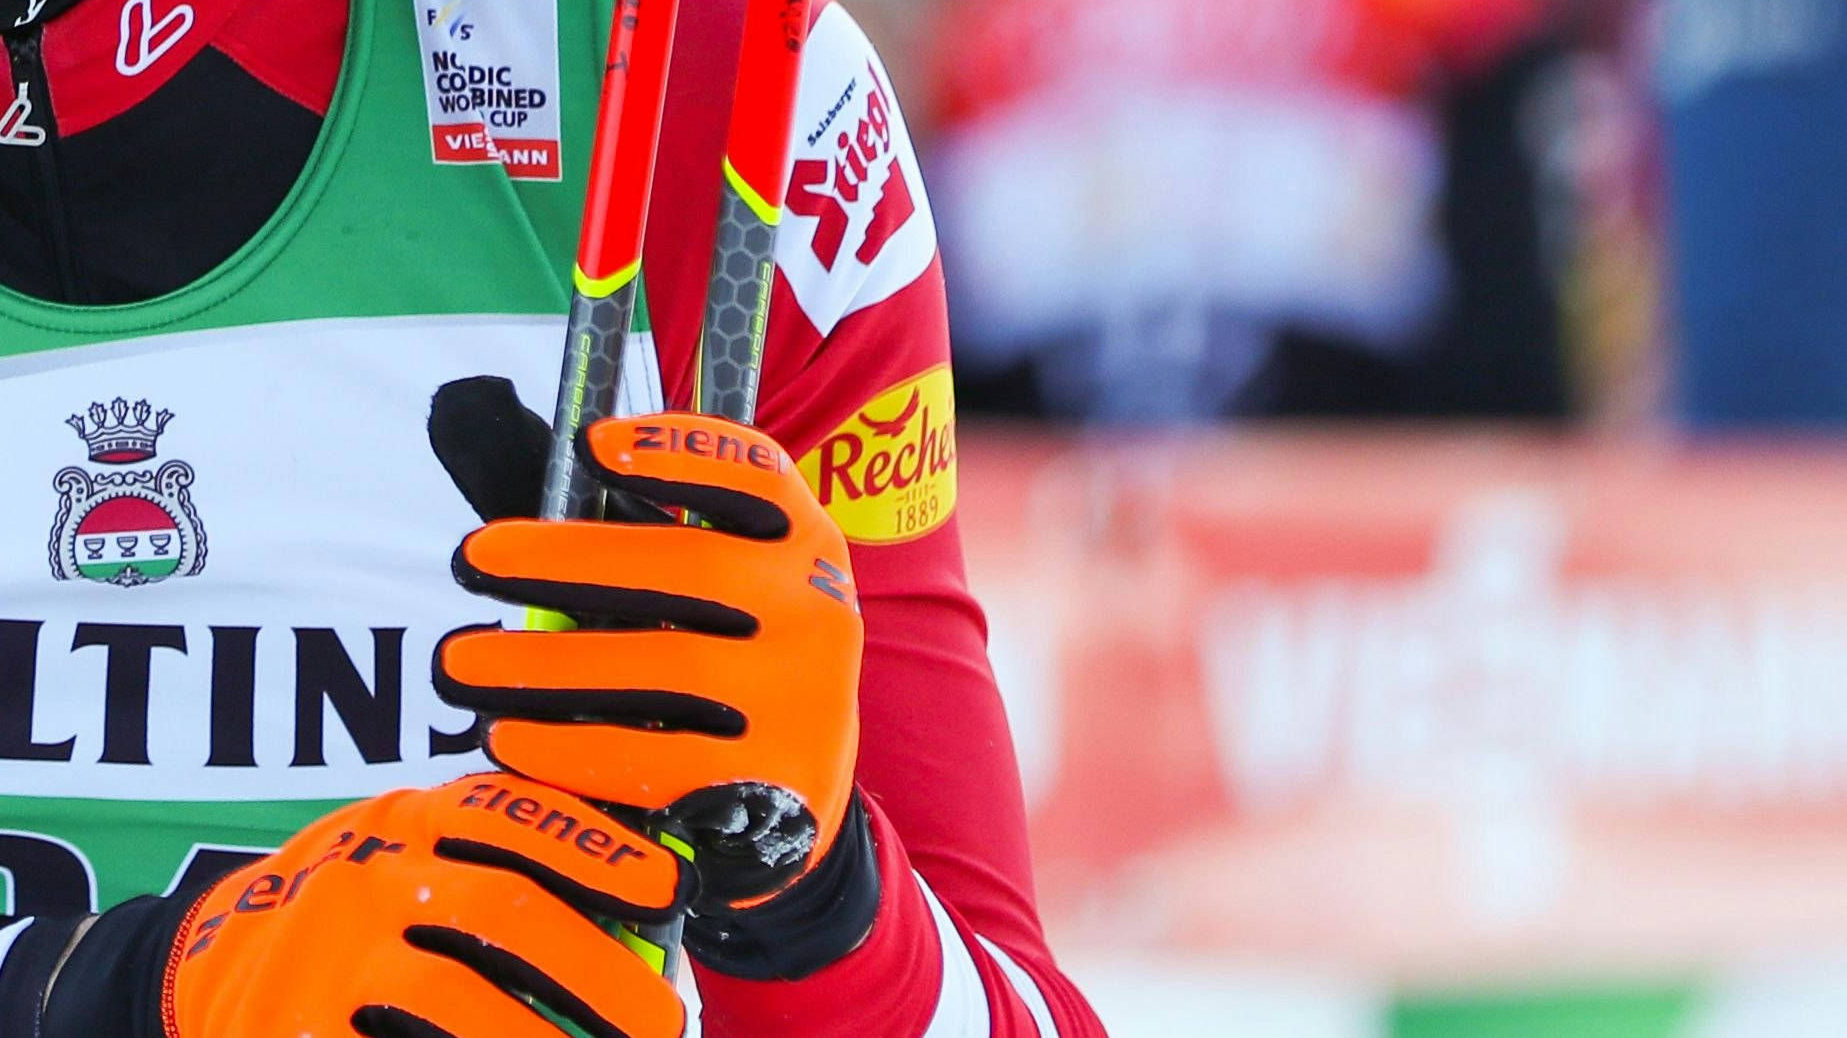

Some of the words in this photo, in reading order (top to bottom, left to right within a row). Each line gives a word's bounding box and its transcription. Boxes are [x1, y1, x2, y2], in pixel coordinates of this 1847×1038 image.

[426, 8, 475, 41] FS
[431, 50, 512, 87] NDIC
[436, 72, 547, 109] COBINED
[489, 109, 529, 128] CUP
[807, 75, 857, 148] Salzburger
[444, 128, 548, 166] VIEANN
[784, 57, 891, 275] Stiegl
[633, 425, 793, 476] ziener
[816, 405, 955, 508] Reche
[895, 495, 939, 535] 1889
[458, 783, 649, 868] ziener
